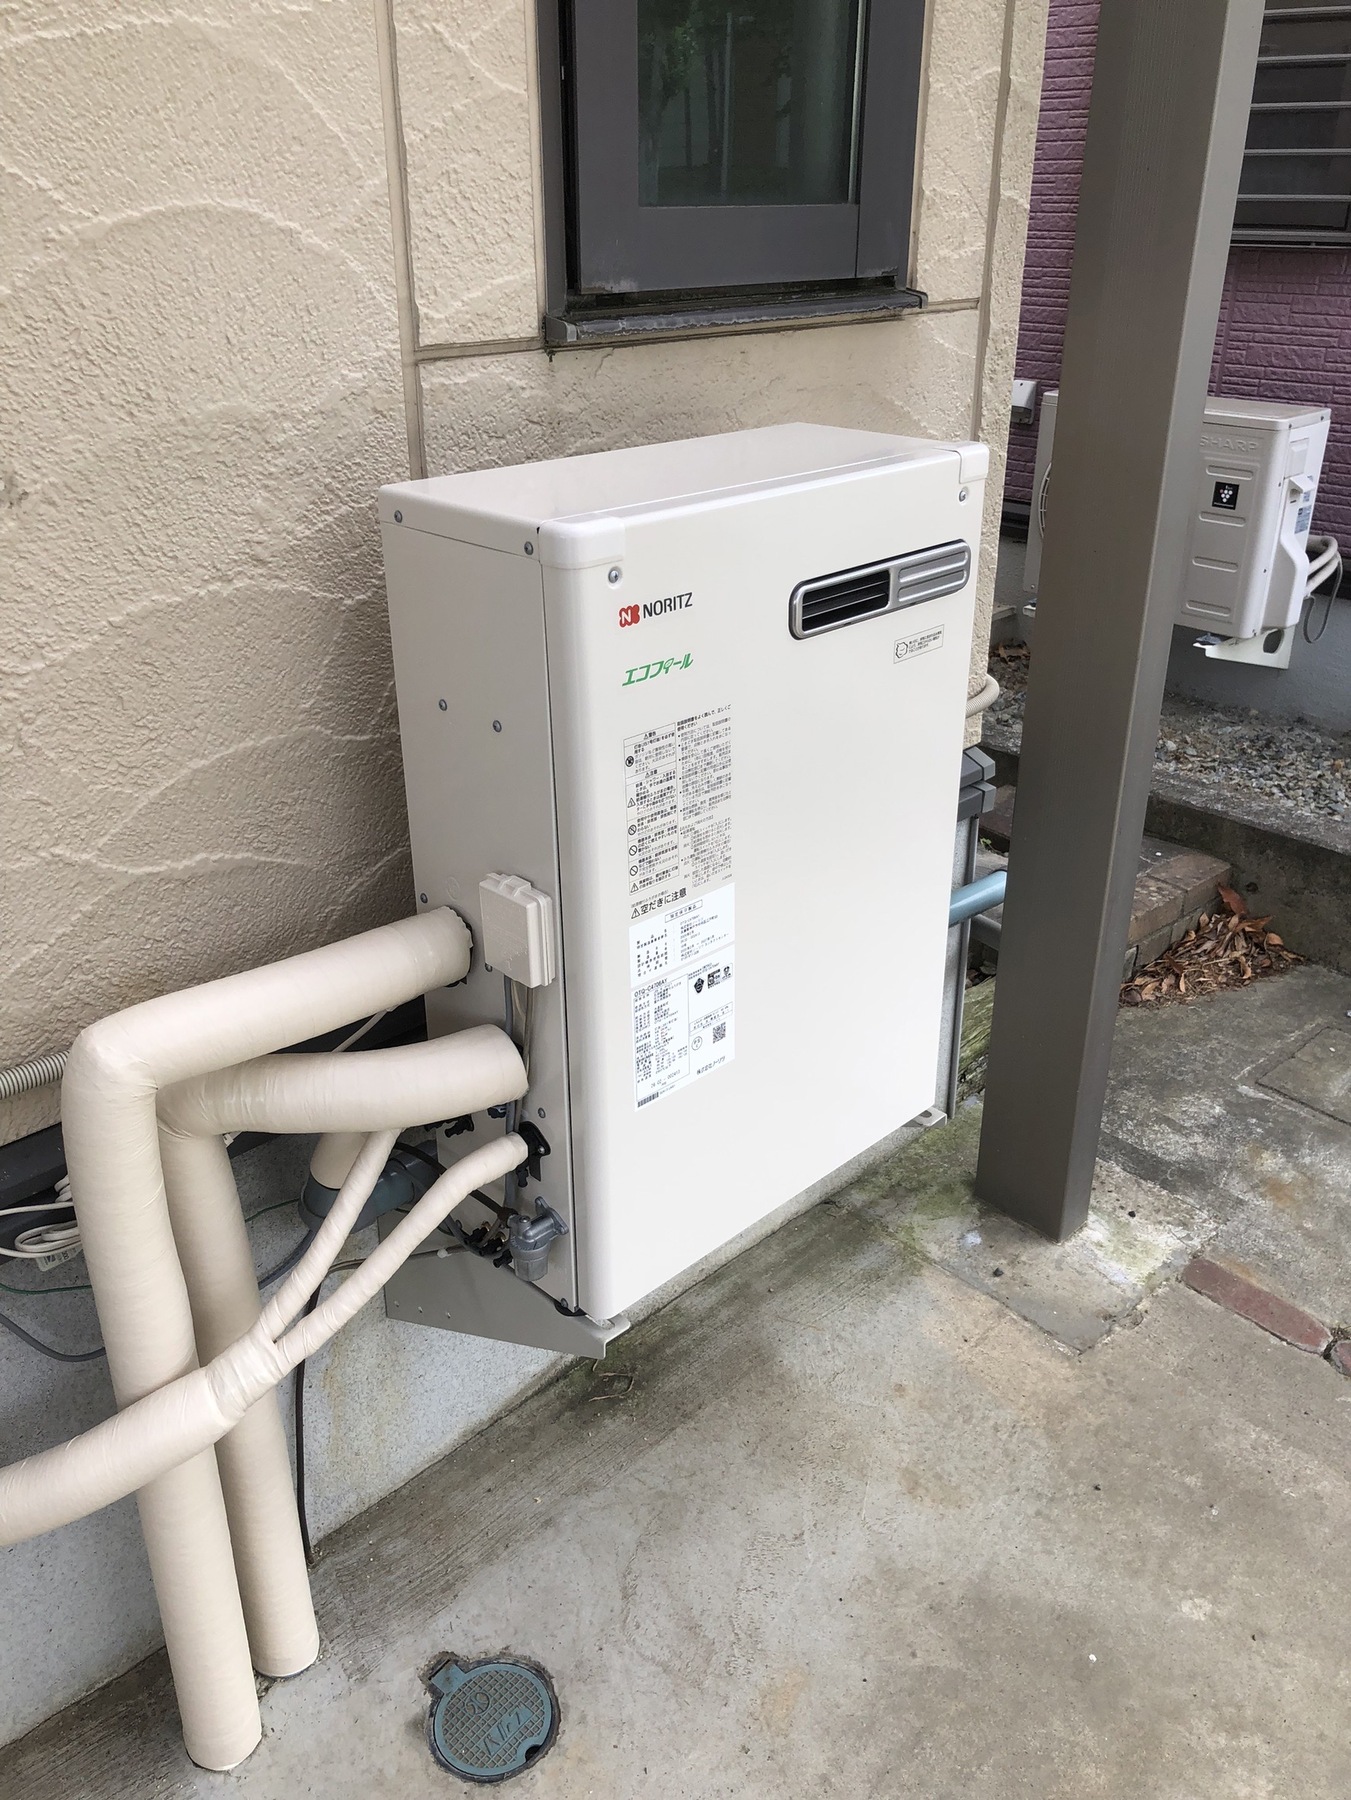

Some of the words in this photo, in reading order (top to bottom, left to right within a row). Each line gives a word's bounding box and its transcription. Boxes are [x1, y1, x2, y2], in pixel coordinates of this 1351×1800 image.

[1199, 434, 1260, 452] SHARP
[643, 592, 693, 619] NORITZ
[622, 653, 694, 687] エコフィール
[640, 887, 687, 916] 空だきに注意
